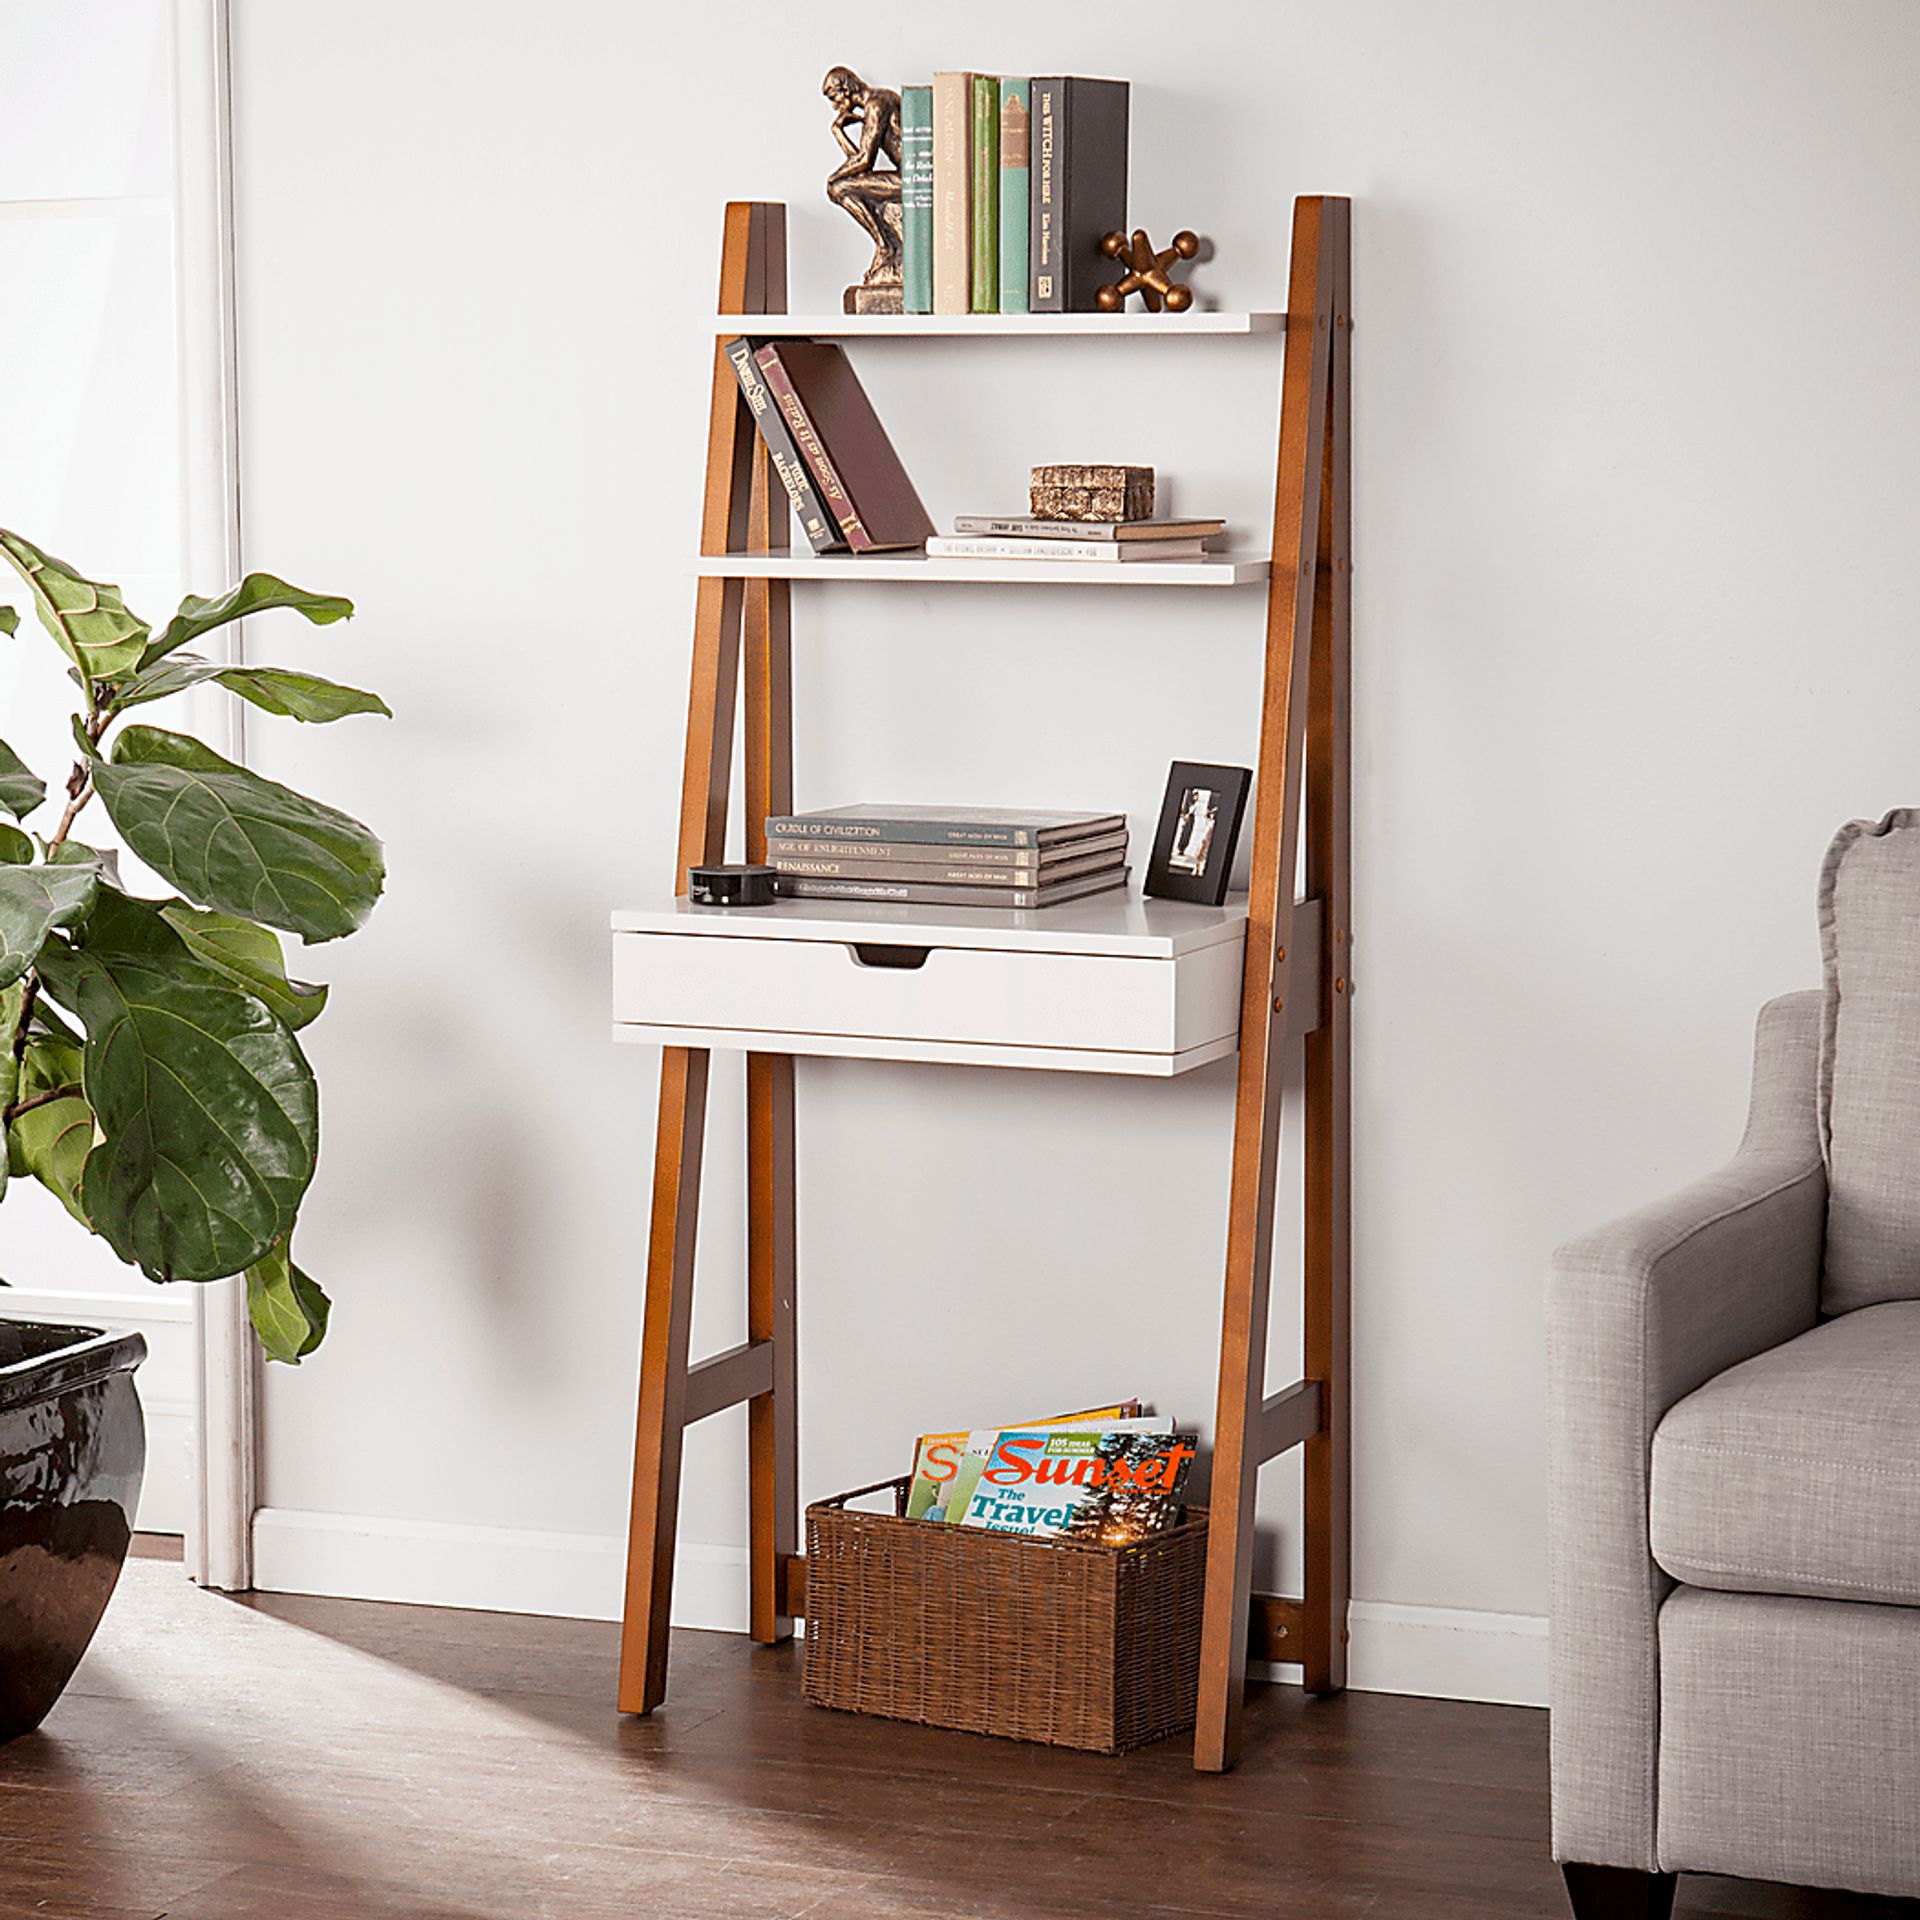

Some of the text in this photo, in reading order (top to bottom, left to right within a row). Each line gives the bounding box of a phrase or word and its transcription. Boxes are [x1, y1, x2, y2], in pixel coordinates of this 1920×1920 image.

[1042, 115, 1053, 159] WITCH
[782, 392, 806, 429] Rains
[807, 442, 821, 456] as
[815, 457, 835, 485] Soon
[828, 484, 844, 500] As
[775, 823, 881, 836] CRADLE OF CIVILIZATION
[778, 842, 892, 857] AGE OF ENLIGHTENMENT
[776, 861, 840, 874] RENAISSANCE
[1050, 1438, 1068, 1448] 105
[983, 1439, 1196, 1490] Sunset
[998, 1488, 1026, 1501] The
[971, 1494, 1075, 1529] Travel
